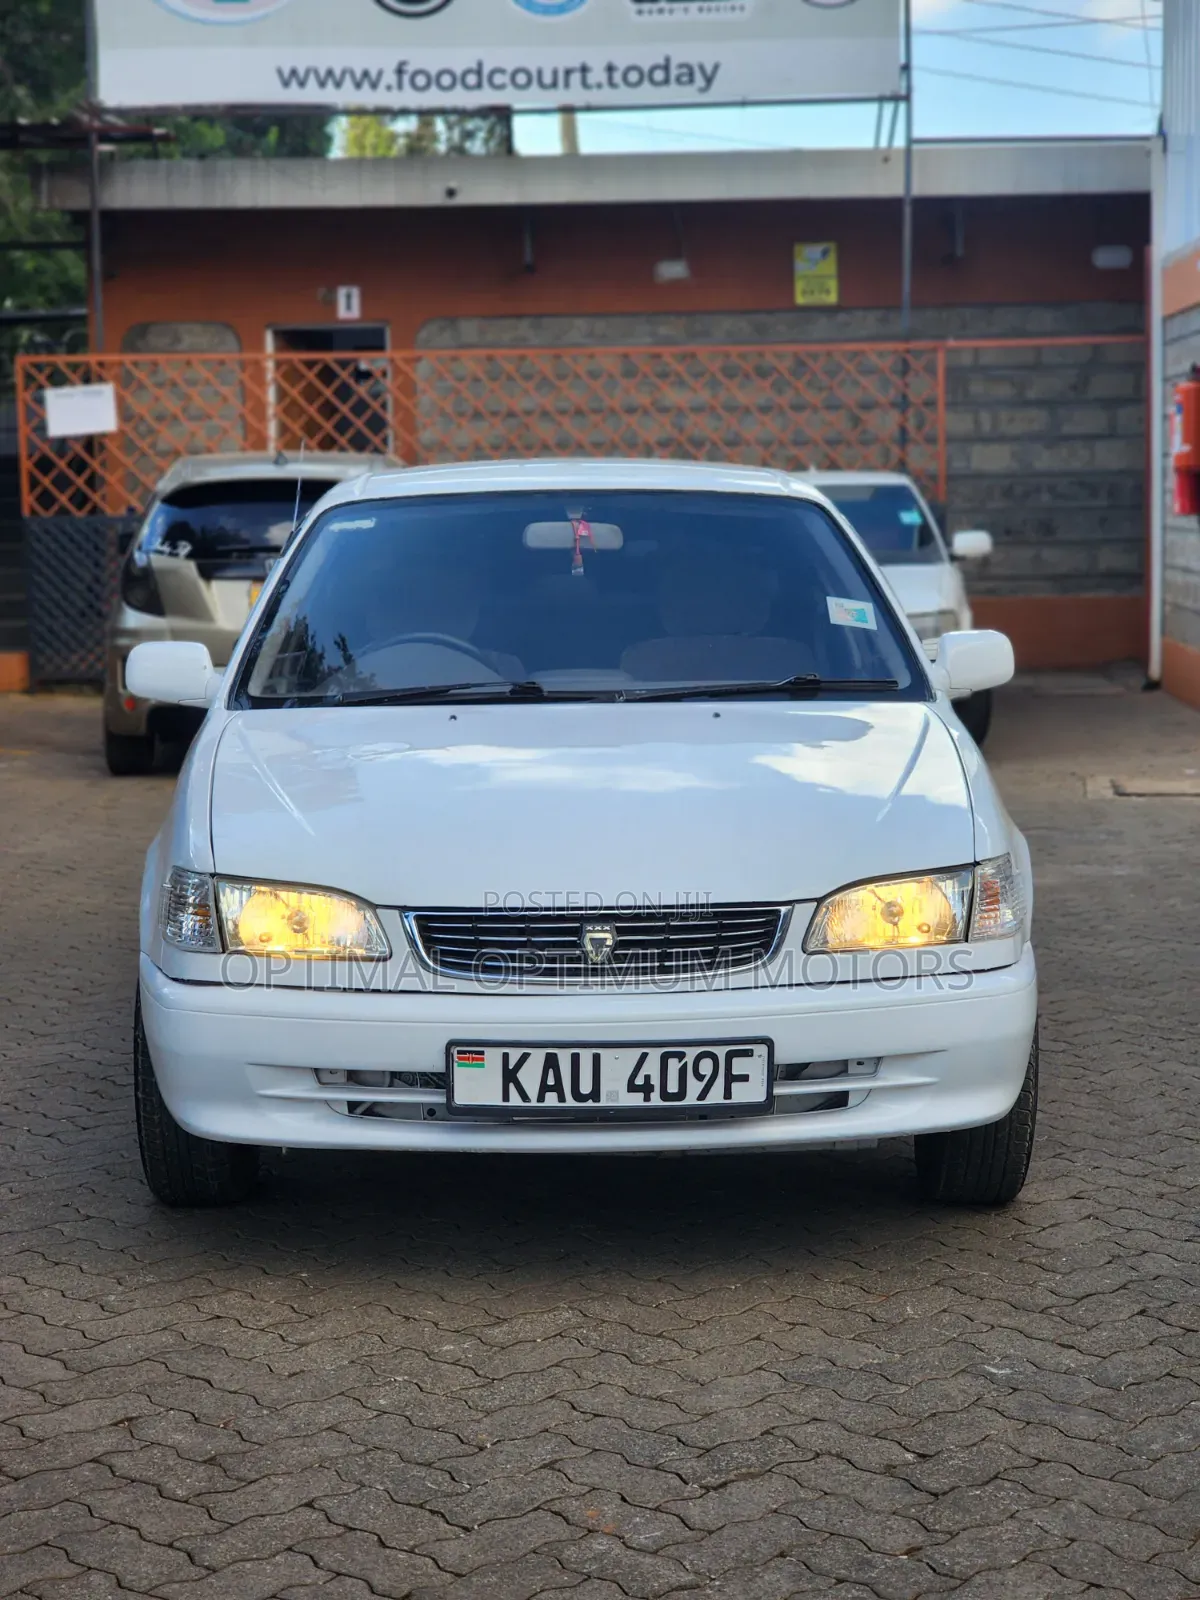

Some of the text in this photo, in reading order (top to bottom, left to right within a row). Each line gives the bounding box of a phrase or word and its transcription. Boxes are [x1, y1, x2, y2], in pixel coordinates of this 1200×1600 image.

[276, 54, 721, 93] www.foodcourt.today
[501, 1051, 601, 1104] KAU
[626, 1048, 755, 1103] 409F
